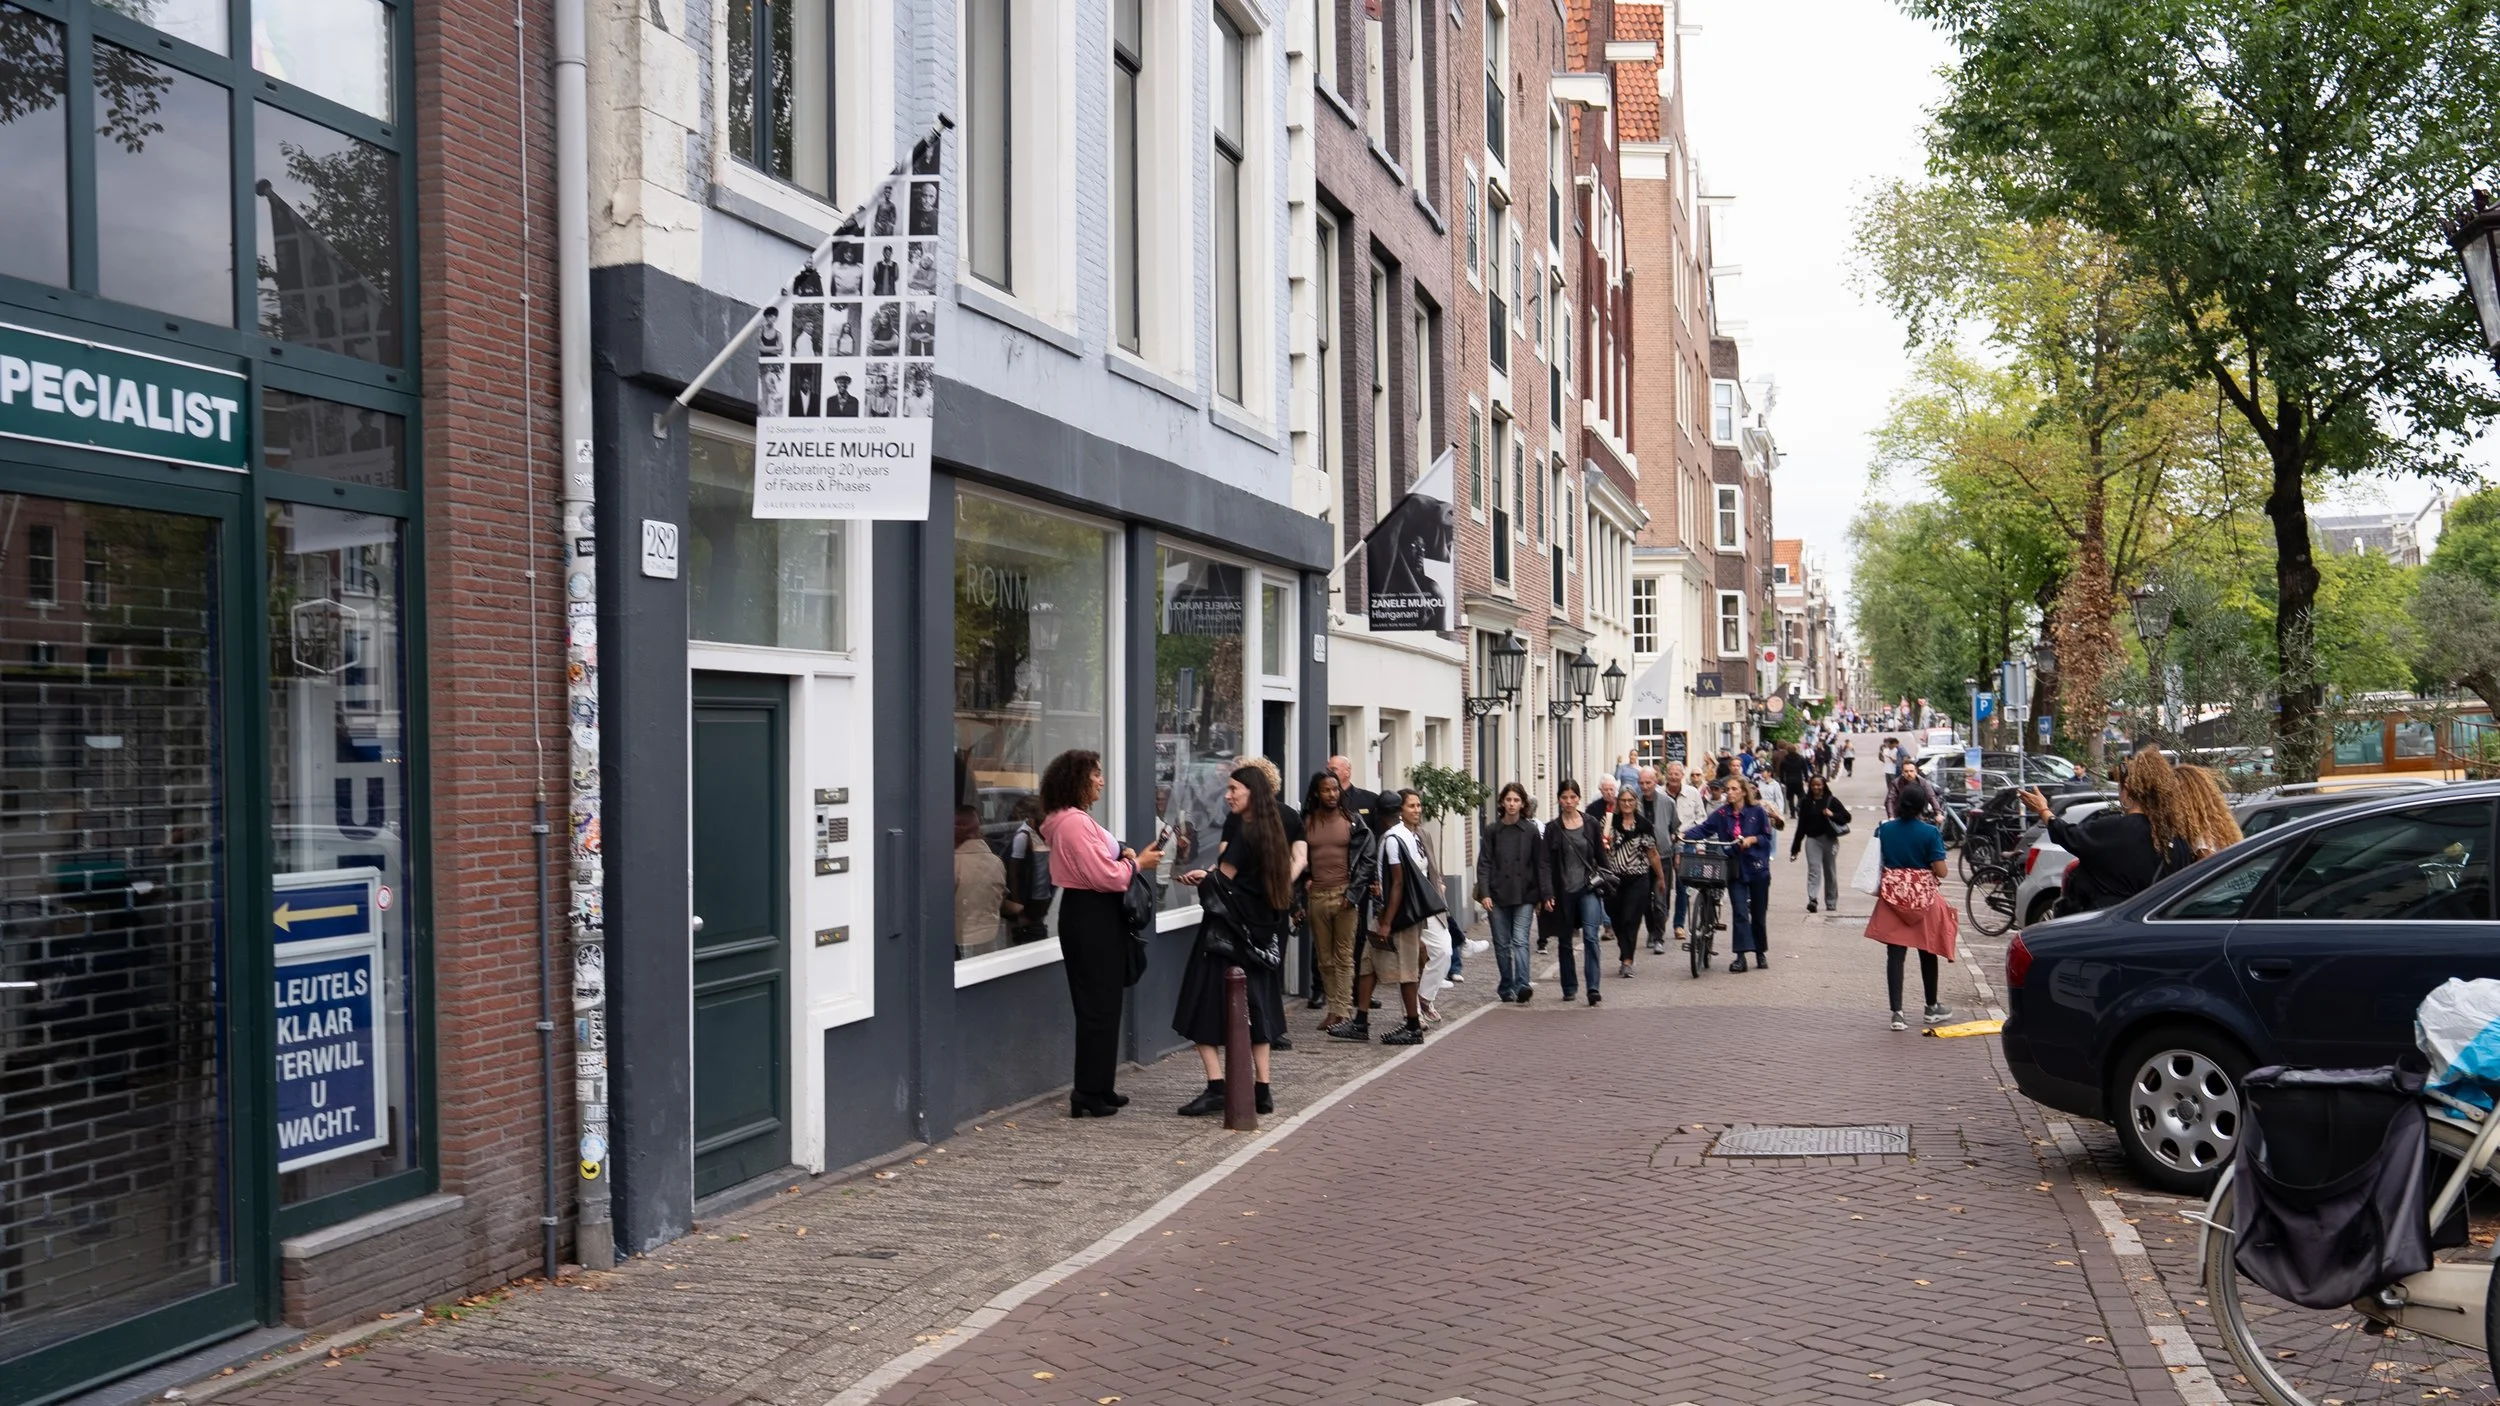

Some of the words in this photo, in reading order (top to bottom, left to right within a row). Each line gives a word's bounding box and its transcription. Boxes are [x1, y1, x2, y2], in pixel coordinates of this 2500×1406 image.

[0, 354, 238, 442] PECIALIST
[765, 441, 835, 458] ZANELE
[840, 441, 914, 458] MUHOLI
[765, 462, 836, 478] Celebrating
[838, 463, 854, 476] 20
[857, 465, 890, 479] years
[764, 477, 778, 492] of
[780, 479, 814, 492] Faces
[816, 479, 826, 492] &
[829, 479, 872, 492] Phases
[647, 524, 676, 560] 282
[1371, 598, 1407, 608] ZANELE
[1407, 598, 1446, 608] MUHOLI
[1371, 609, 1419, 620] Hlanganani
[1980, 700, 1988, 711] P
[274, 968, 368, 1008] LEUTELS
[277, 1007, 353, 1045] KLAAR
[311, 1079, 327, 1108] U
[277, 1106, 360, 1149] WACHT.
